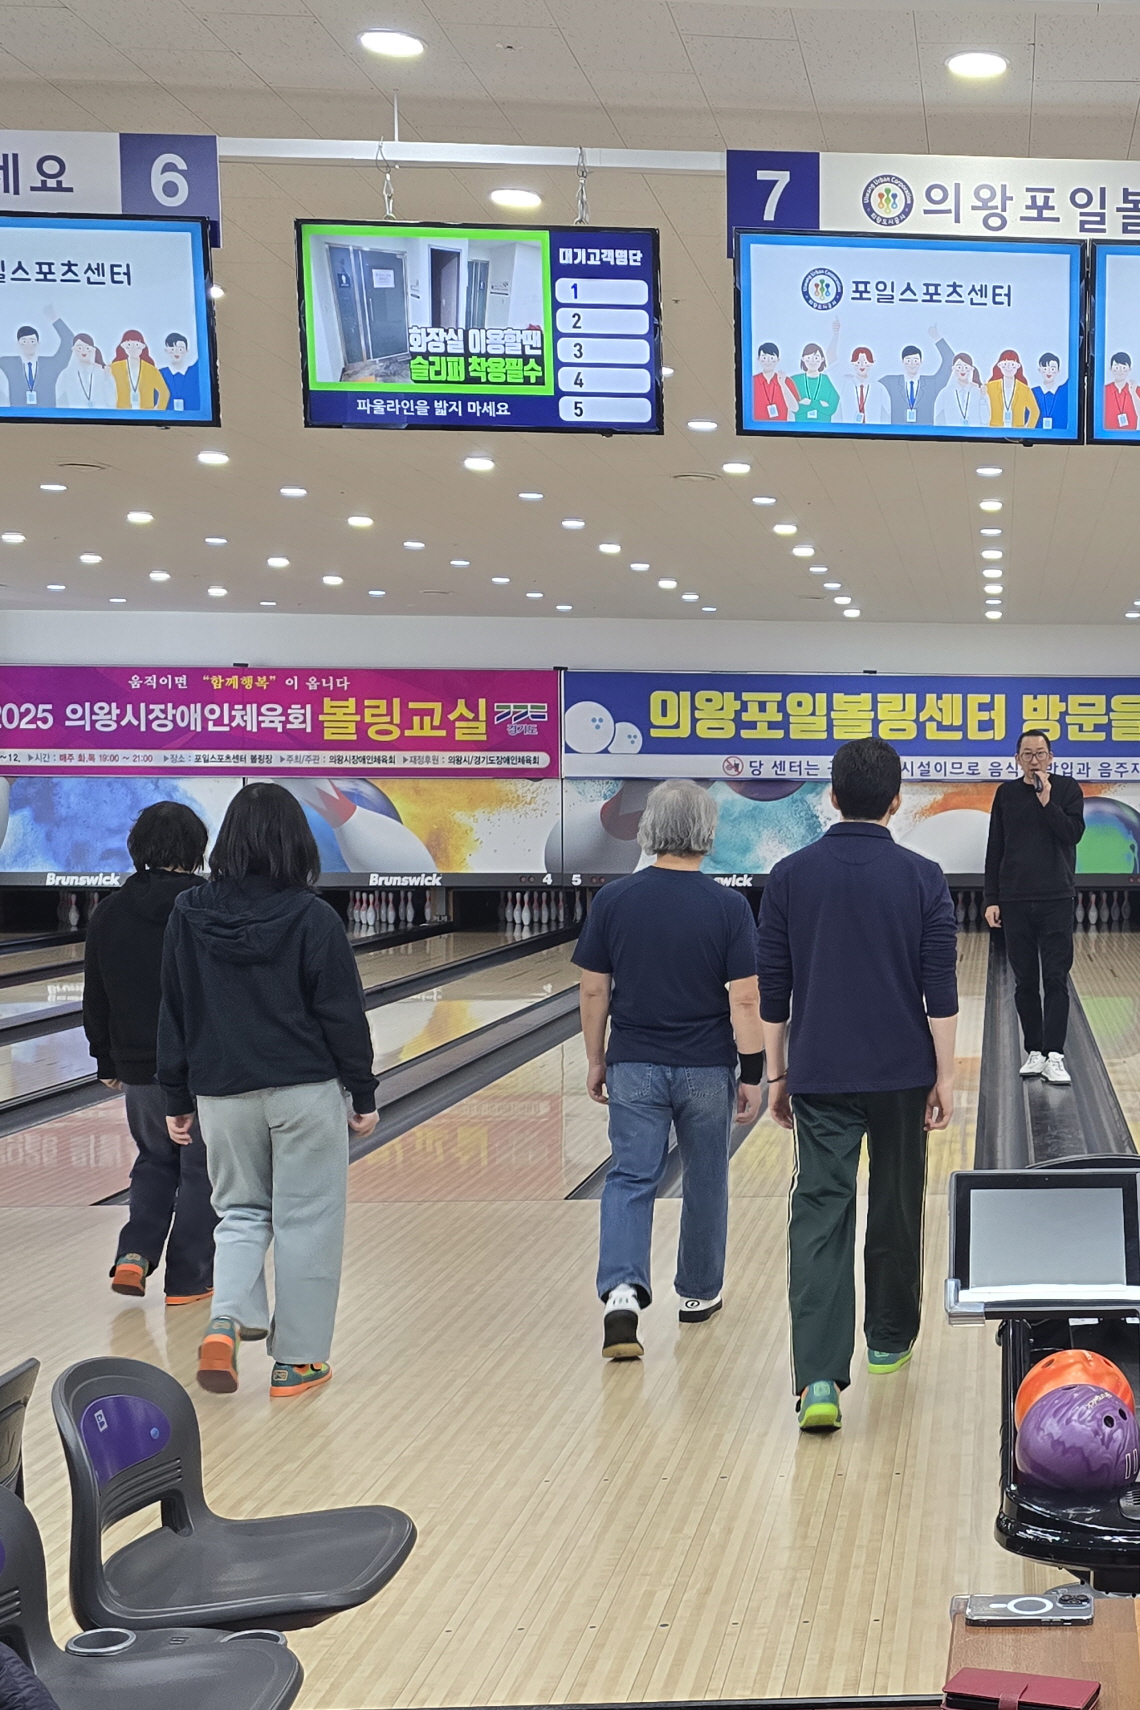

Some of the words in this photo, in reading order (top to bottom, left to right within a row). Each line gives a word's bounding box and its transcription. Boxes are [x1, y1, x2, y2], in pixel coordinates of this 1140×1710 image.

[150, 152, 189, 207] 6
[756, 170, 791, 221] 7
[558, 247, 643, 266] 대기고객명단
[570, 283, 579, 300] 1
[850, 279, 1012, 308] 포일스포츠센터
[571, 313, 582, 330] 2
[408, 326, 465, 353] 화장실
[572, 342, 583, 359] 3
[409, 356, 466, 381] 슬리퍼
[468, 357, 543, 383] 착용필수
[573, 372, 584, 388] 4
[356, 398, 429, 417] 파울라인을
[433, 400, 462, 416] 밟지
[467, 402, 511, 418] 마세요
[573, 401, 584, 417] 5
[128, 674, 188, 690] 움직이면
[285, 675, 298, 691] 이
[0, 702, 54, 730] 025
[64, 702, 312, 732] 의왕시장애인체육회
[318, 697, 488, 742] 볼링교실
[649, 690, 1006, 741] 의왕포일볼링센터
[35, 753, 50, 763] 시간
[749, 760, 765, 776] 당
[771, 760, 821, 776] 센터는
[45, 872, 122, 887] Brunswick
[369, 872, 443, 887] Brunswick
[542, 874, 553, 886] 4
[571, 874, 582, 886] 5
